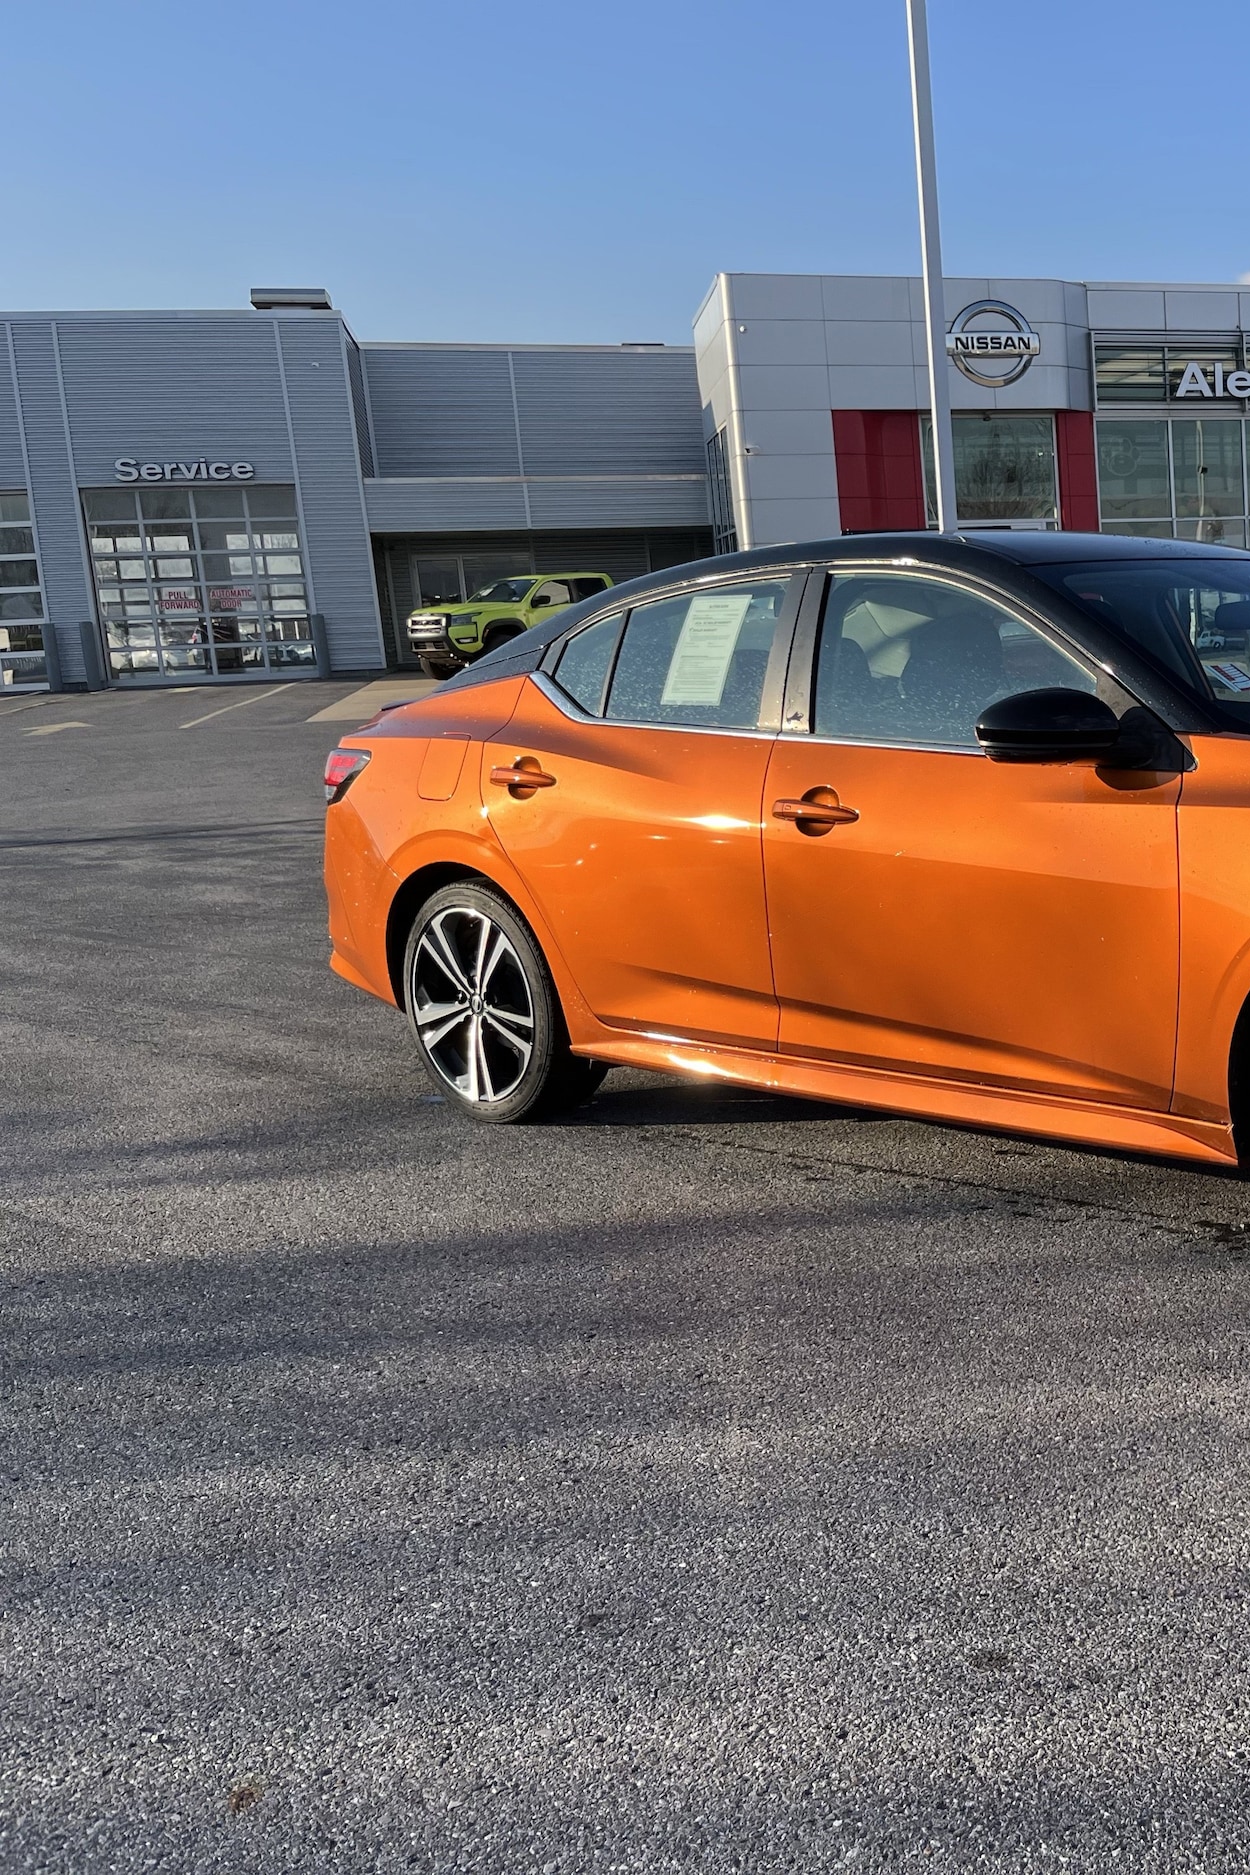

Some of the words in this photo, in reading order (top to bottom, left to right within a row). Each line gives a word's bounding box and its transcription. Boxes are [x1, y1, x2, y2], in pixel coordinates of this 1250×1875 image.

[954, 336, 1031, 350] NISSAN
[114, 457, 255, 482] Service
[168, 591, 189, 600] PULL
[210, 589, 252, 599] AUTOMATIC
[160, 600, 200, 610] FORWARD
[220, 599, 242, 608] DOOR
